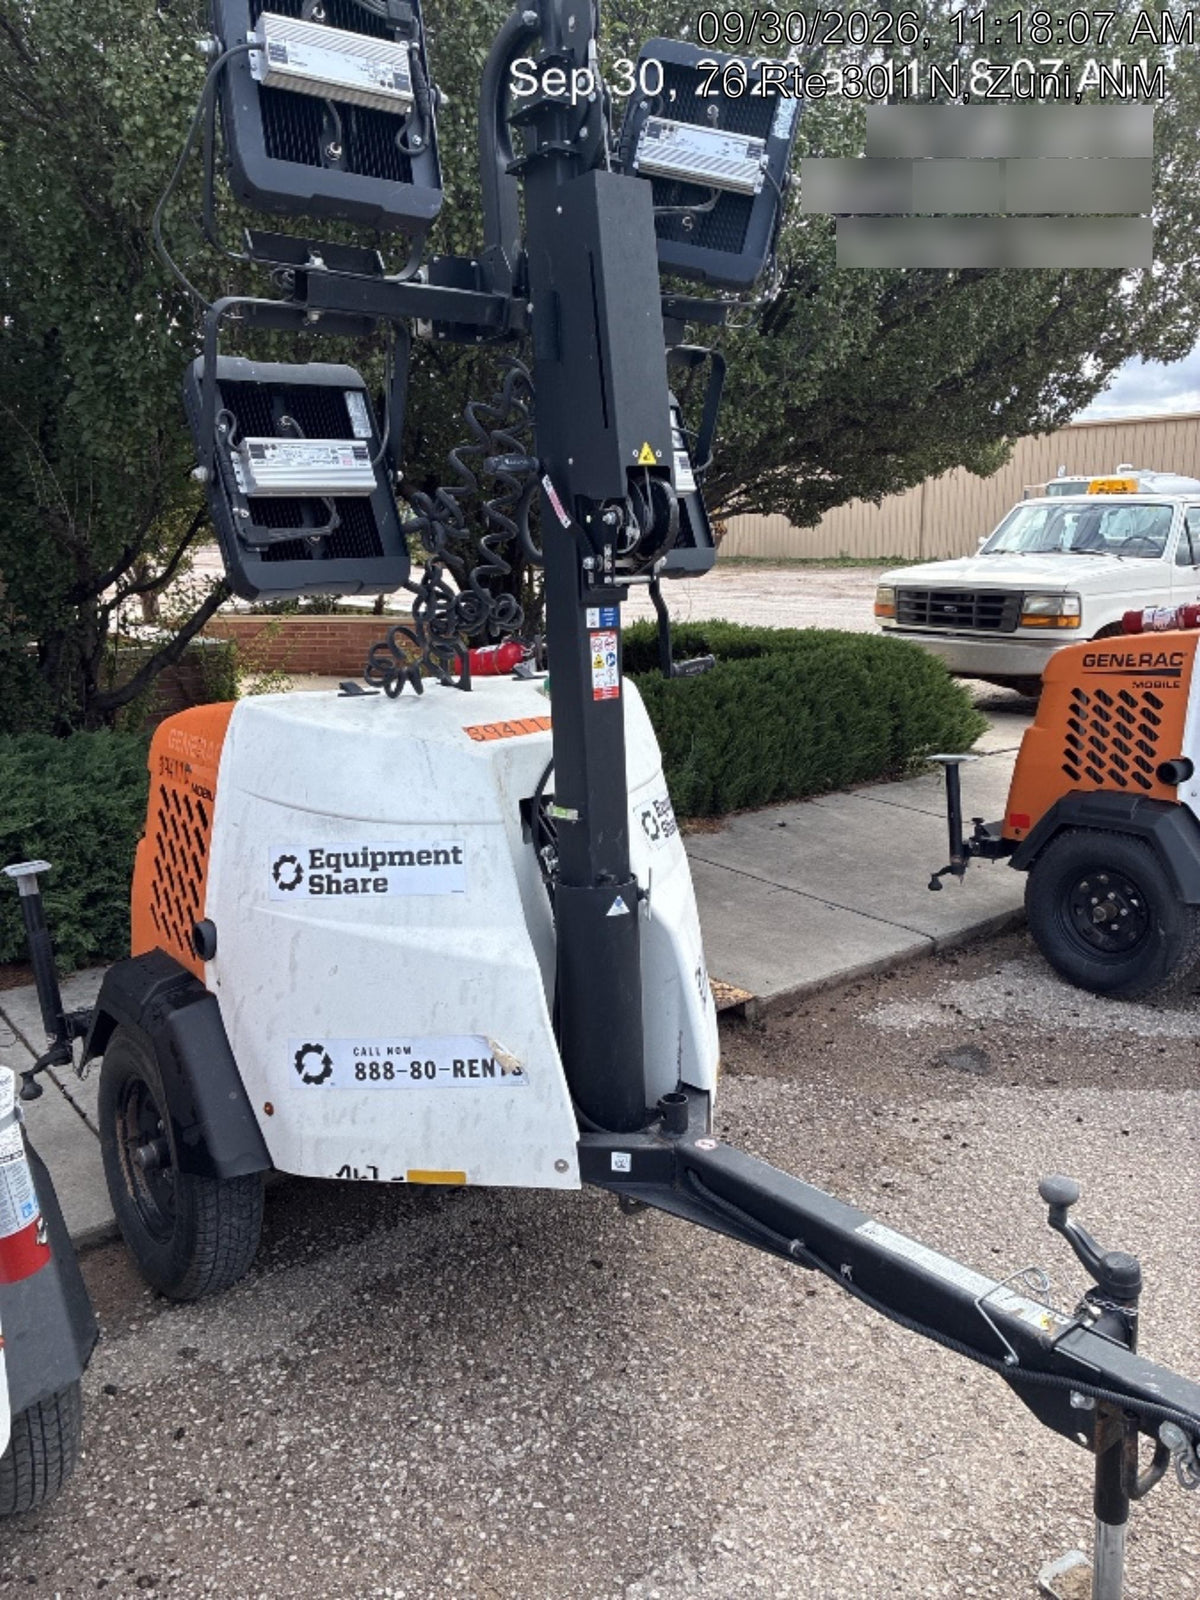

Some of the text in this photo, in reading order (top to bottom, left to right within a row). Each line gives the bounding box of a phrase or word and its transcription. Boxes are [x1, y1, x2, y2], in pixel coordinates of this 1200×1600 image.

[1082, 652, 1183, 667] GENERAC
[1132, 680, 1181, 689] MOBILE
[309, 846, 463, 873] Equipment
[309, 874, 389, 895] Share
[353, 1046, 411, 1057] CALL NOW
[355, 1058, 524, 1081] 888-80-REN
